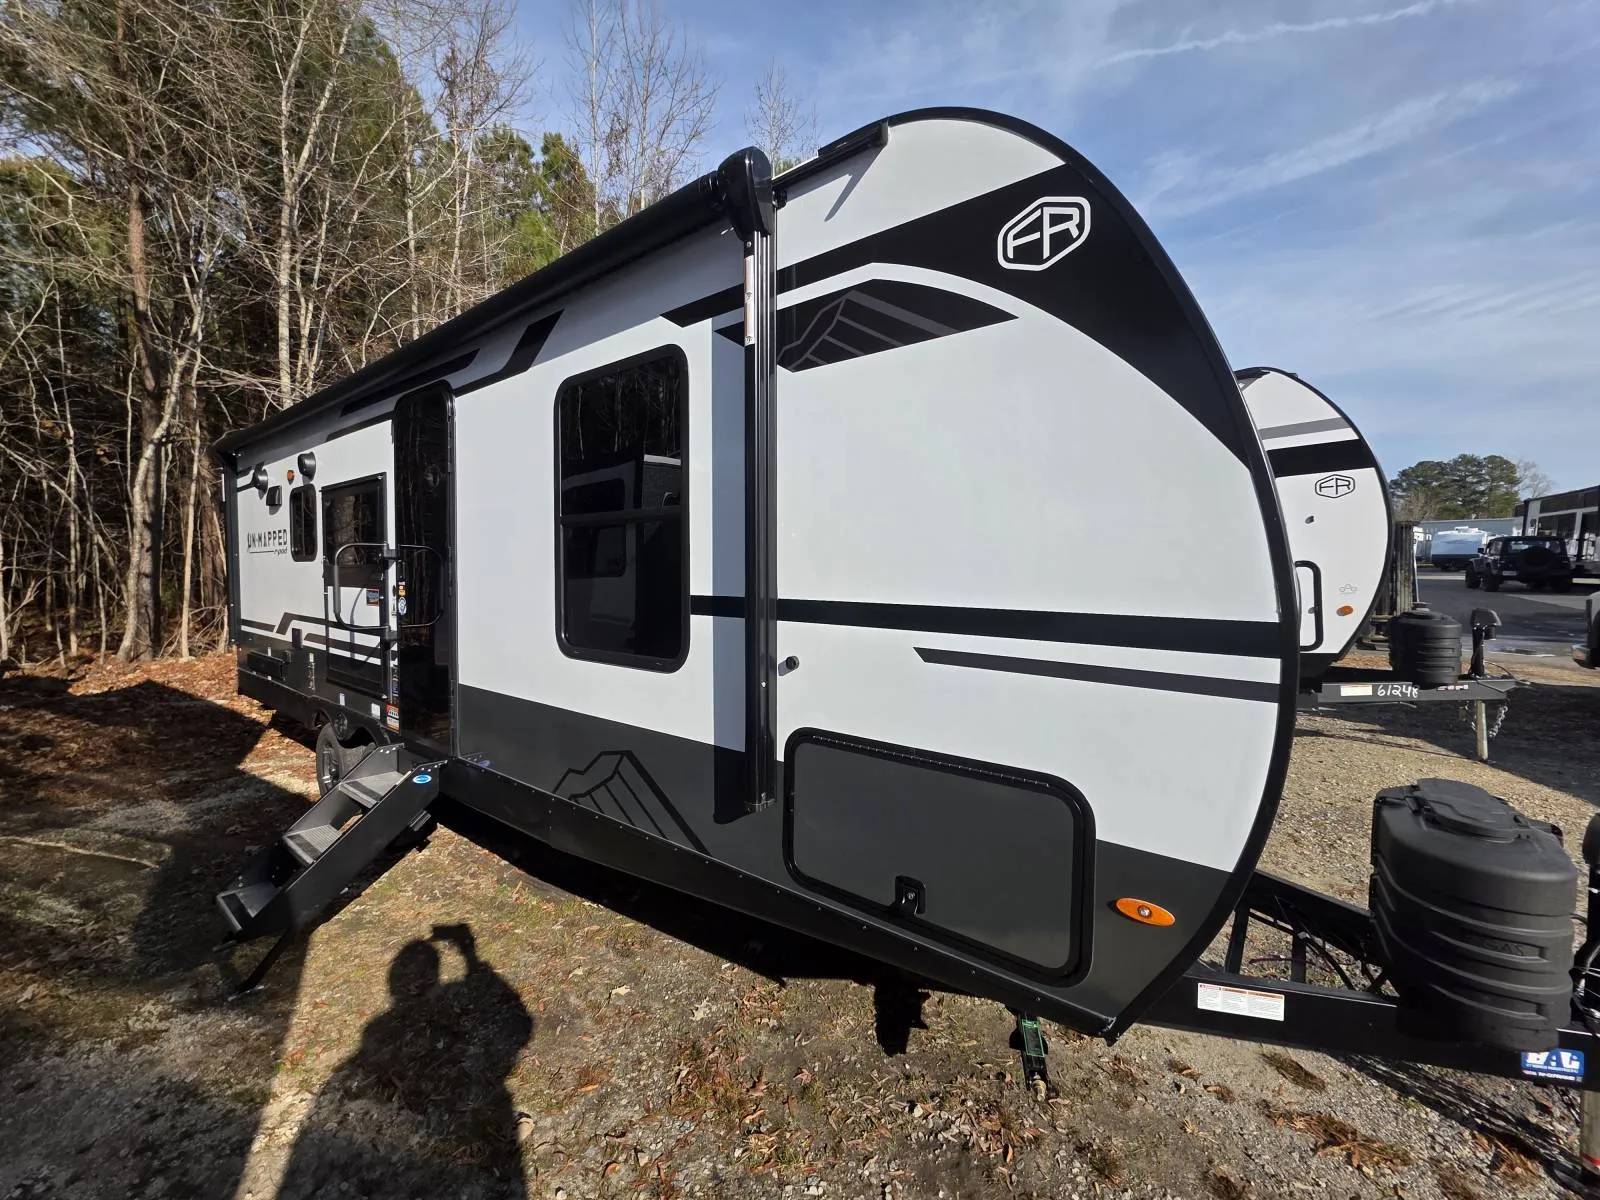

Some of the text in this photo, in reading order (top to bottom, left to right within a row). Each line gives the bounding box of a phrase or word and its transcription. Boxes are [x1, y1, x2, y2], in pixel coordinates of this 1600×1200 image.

[1005, 205, 1081, 261] FR
[1318, 476, 1352, 495] FR
[247, 529, 287, 548] UN-MAPPED
